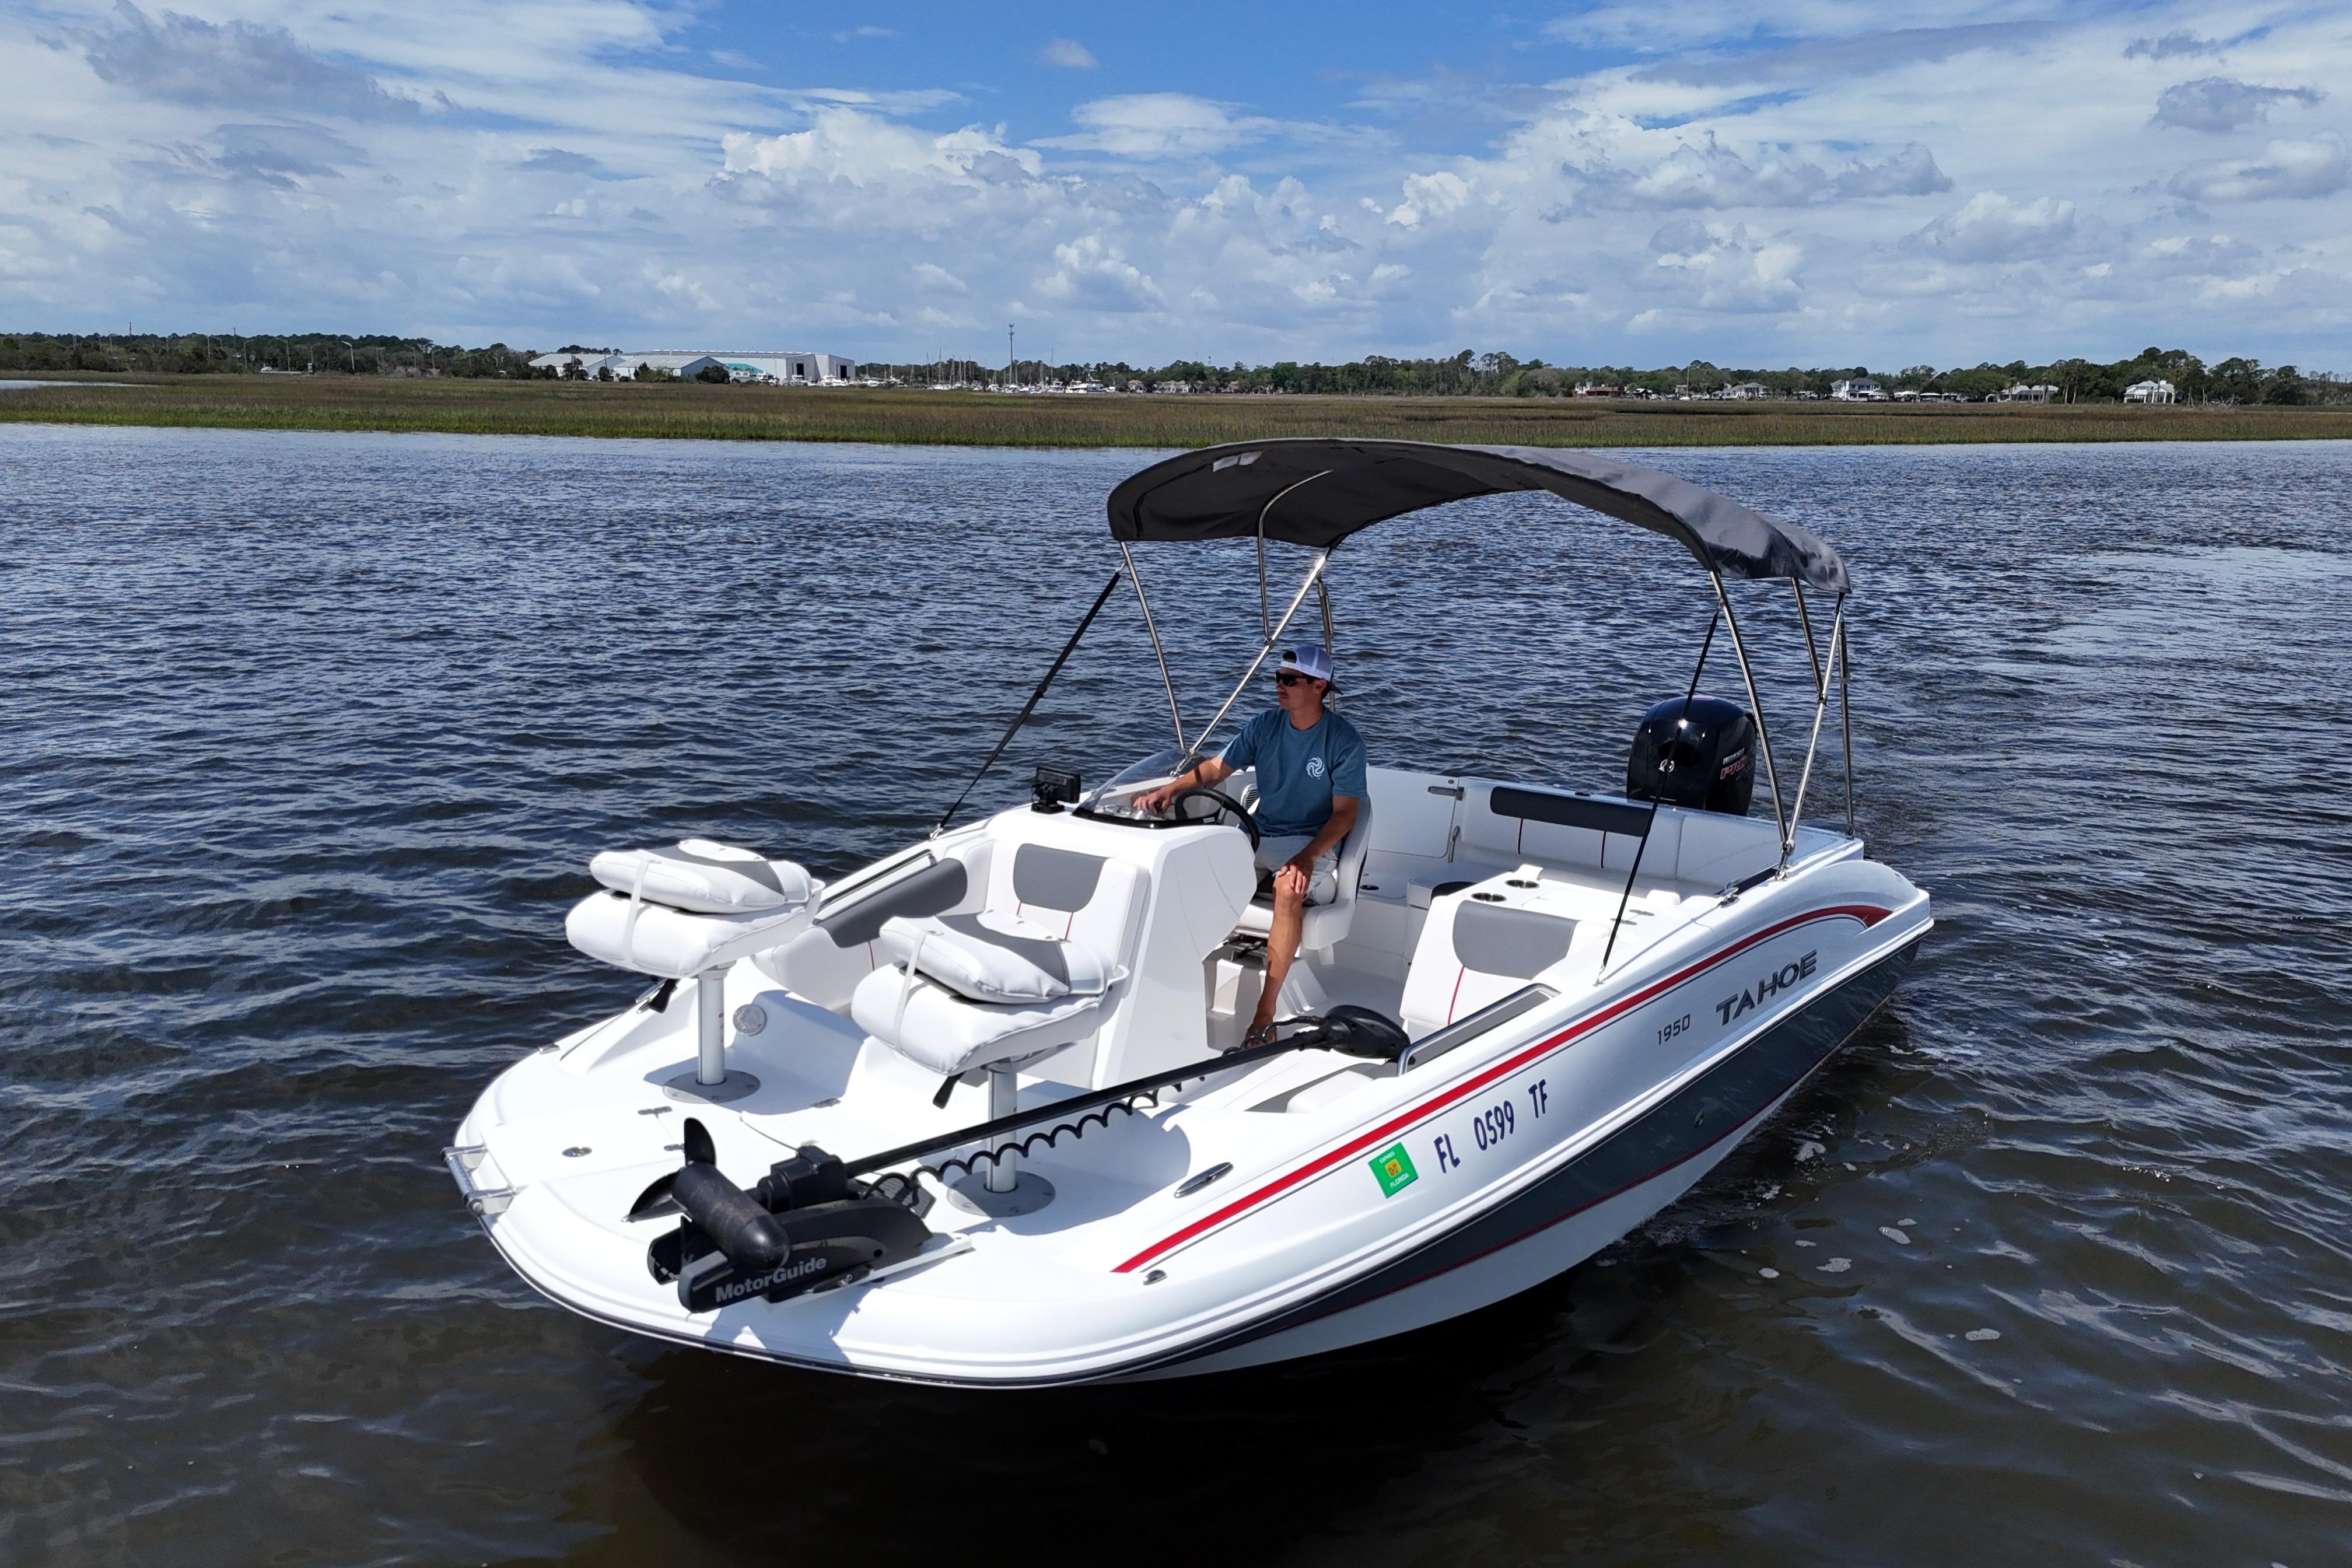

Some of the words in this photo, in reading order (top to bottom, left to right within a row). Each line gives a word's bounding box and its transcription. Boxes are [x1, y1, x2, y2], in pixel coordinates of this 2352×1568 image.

[1657, 1013, 1690, 1045] 1950
[1716, 949, 1817, 1026] TAHOE
[1433, 1133, 1461, 1174] FL
[1474, 1100, 1514, 1151] 0599
[1528, 1079, 1548, 1118] TF
[1390, 1172, 1409, 1188] FLORIDA
[715, 1256, 827, 1303] MotorGuide
